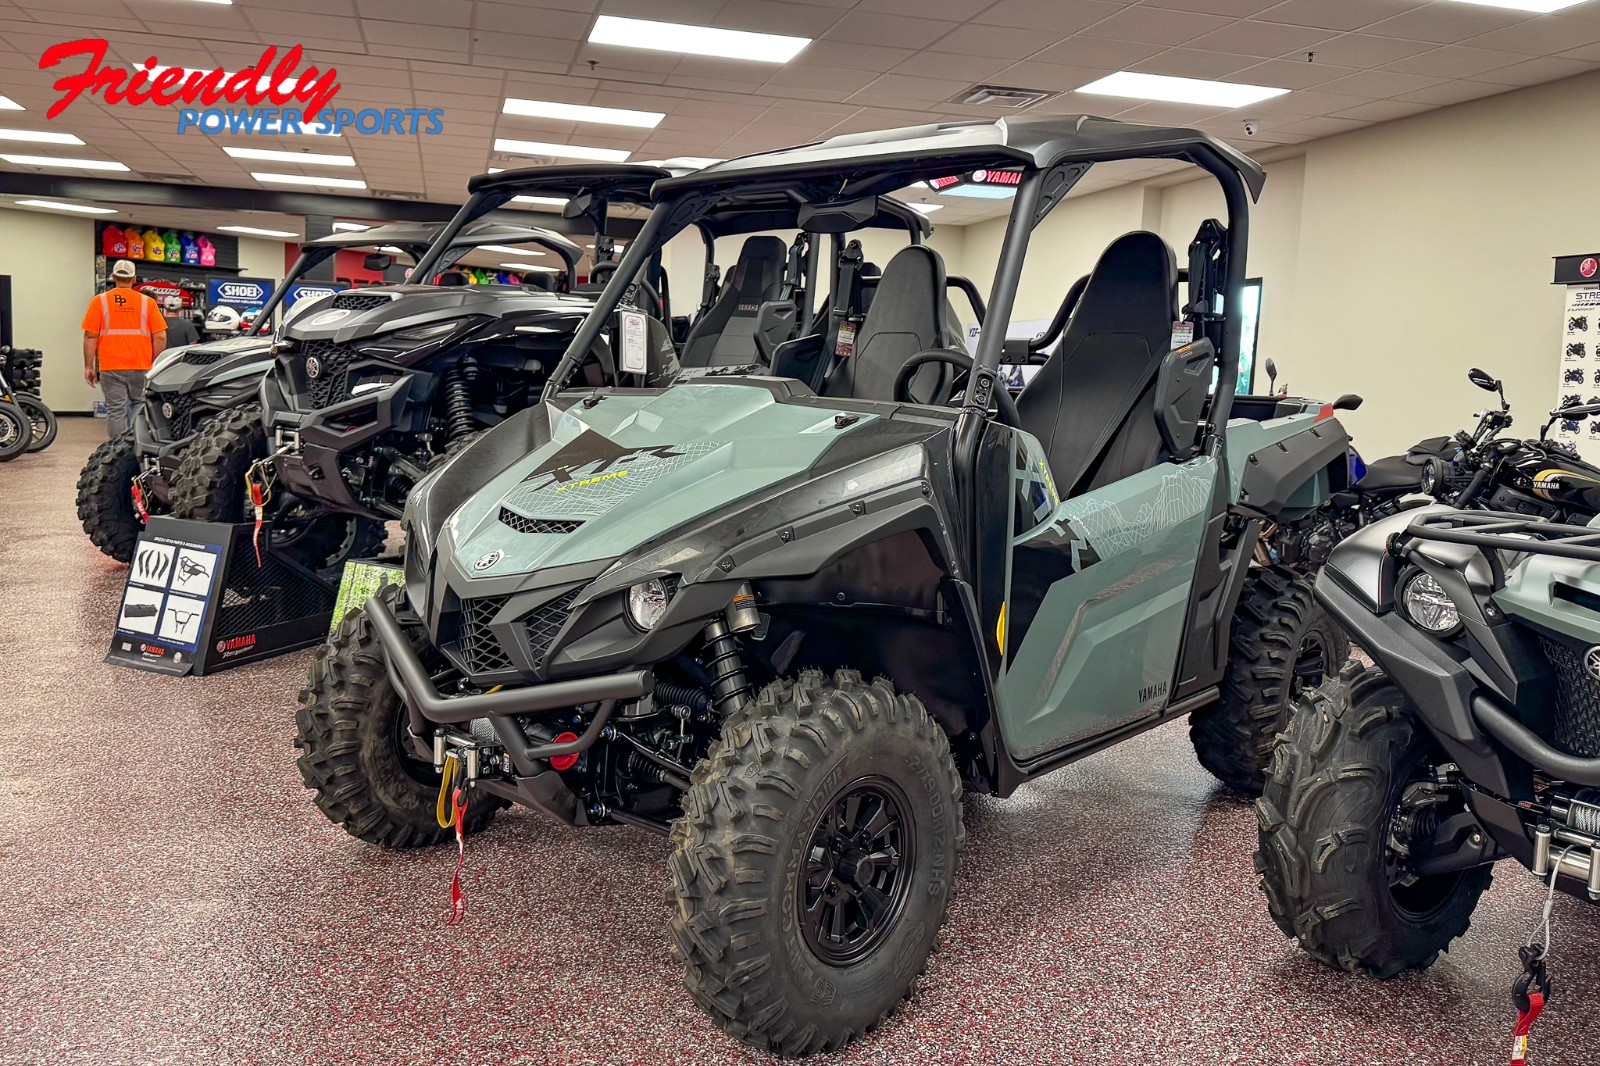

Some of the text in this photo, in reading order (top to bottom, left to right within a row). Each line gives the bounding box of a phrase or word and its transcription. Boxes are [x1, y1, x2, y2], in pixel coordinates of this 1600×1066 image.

[224, 285, 257, 297] SHOEI
[556, 469, 629, 494] XTREME
[1533, 481, 1560, 490] YAMAHA
[225, 633, 257, 650] YAMAHA
[1138, 681, 1167, 703] YAMAHA
